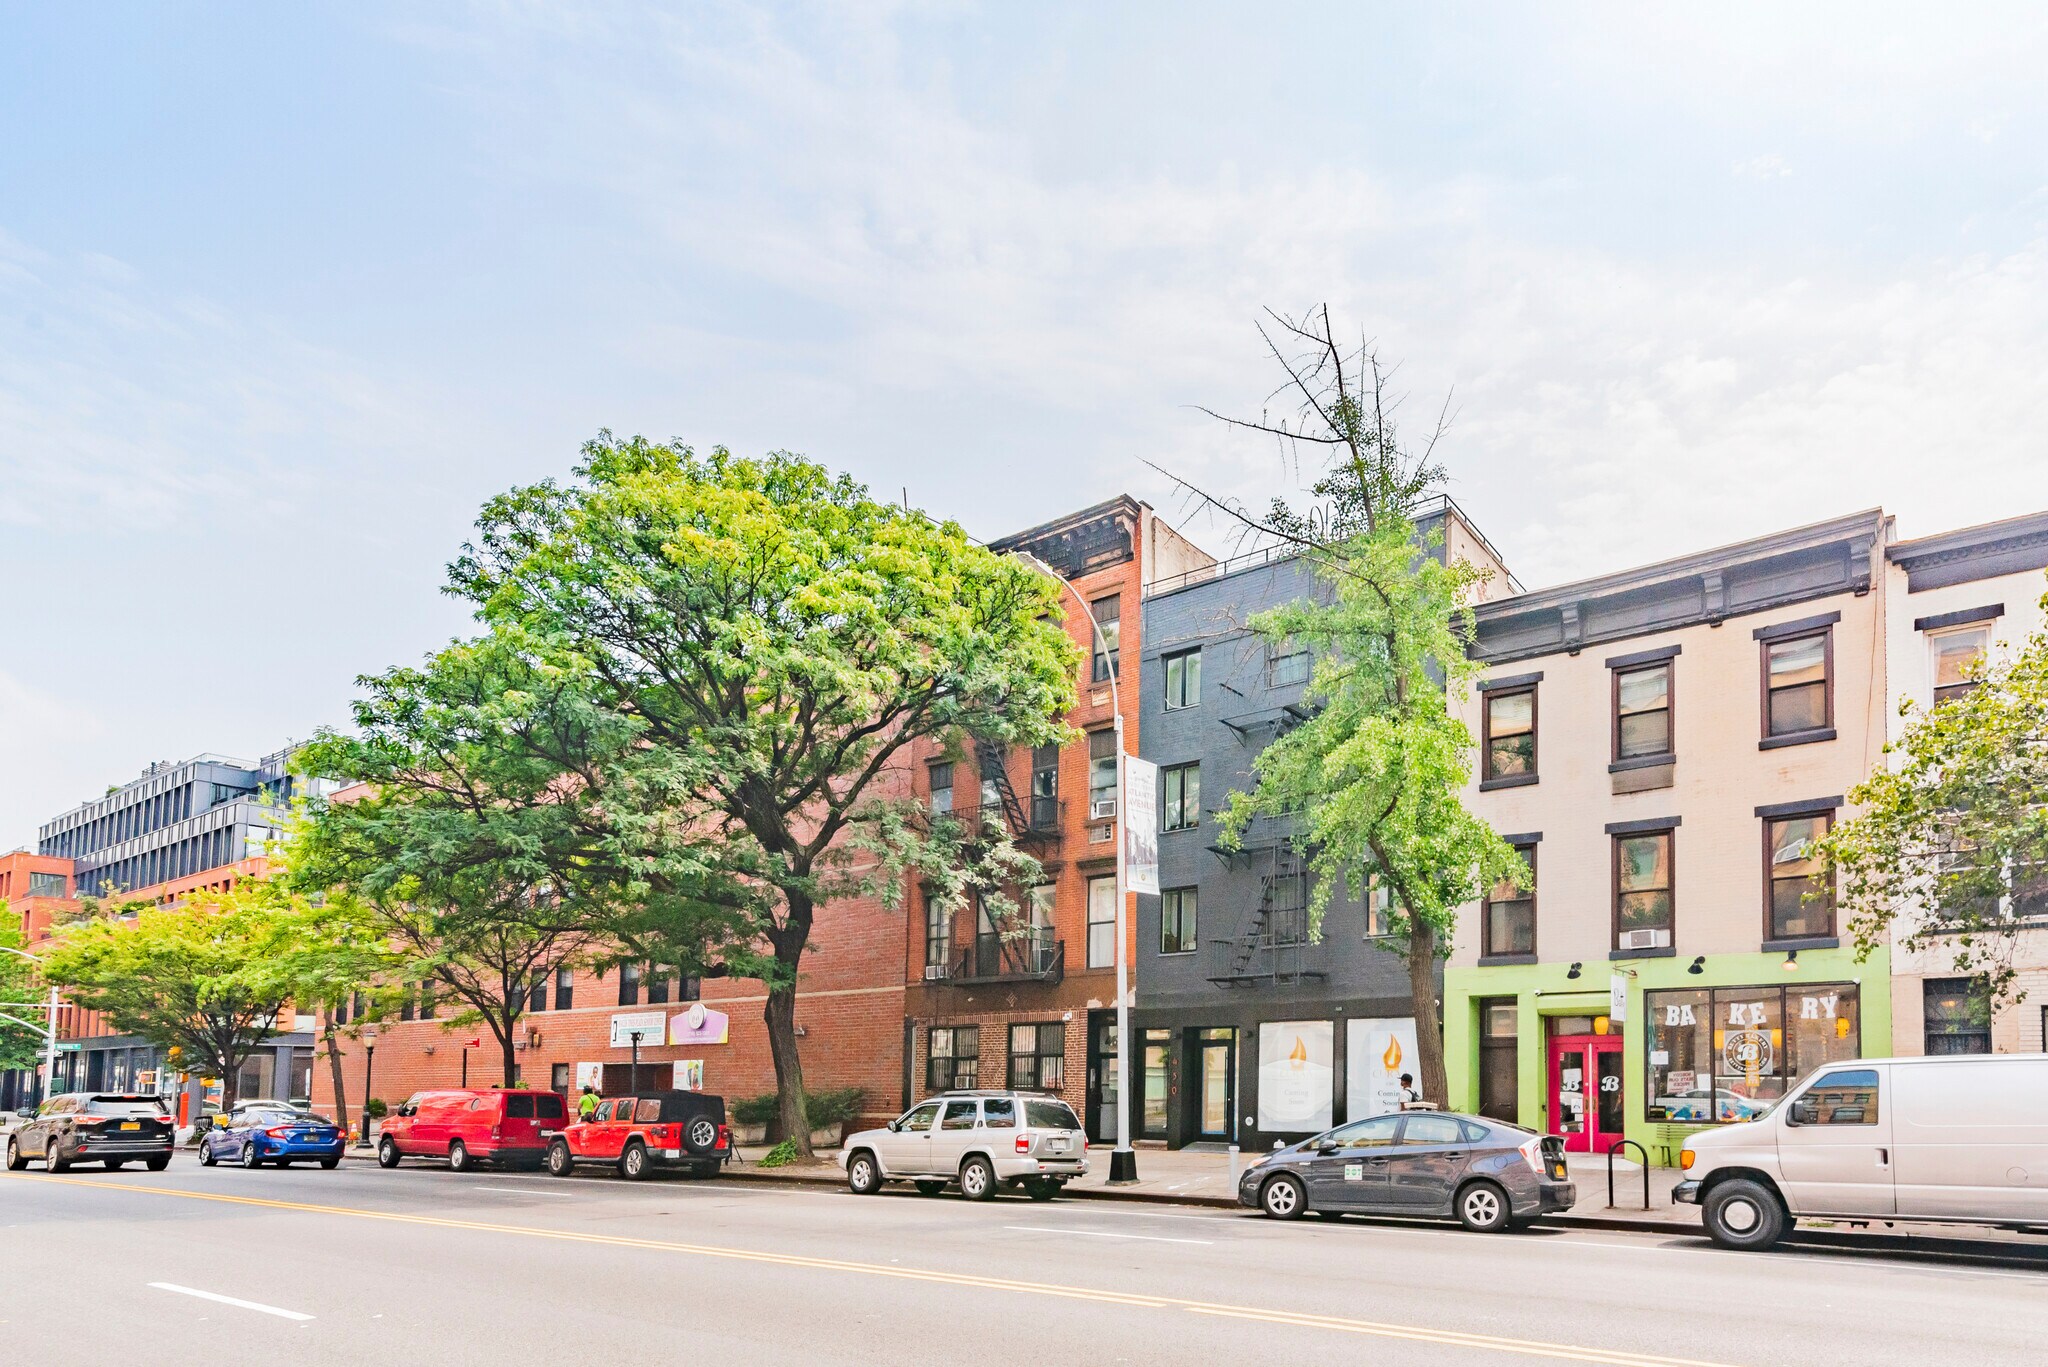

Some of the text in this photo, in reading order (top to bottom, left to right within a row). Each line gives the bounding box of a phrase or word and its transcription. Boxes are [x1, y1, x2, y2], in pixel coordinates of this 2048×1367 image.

[1128, 798, 1155, 812] AVENUE
[1665, 996, 1838, 1026] BA KE RY
[1736, 1043, 1759, 1061] B
[1562, 1077, 1580, 1092] B
[1601, 1076, 1619, 1092] B
